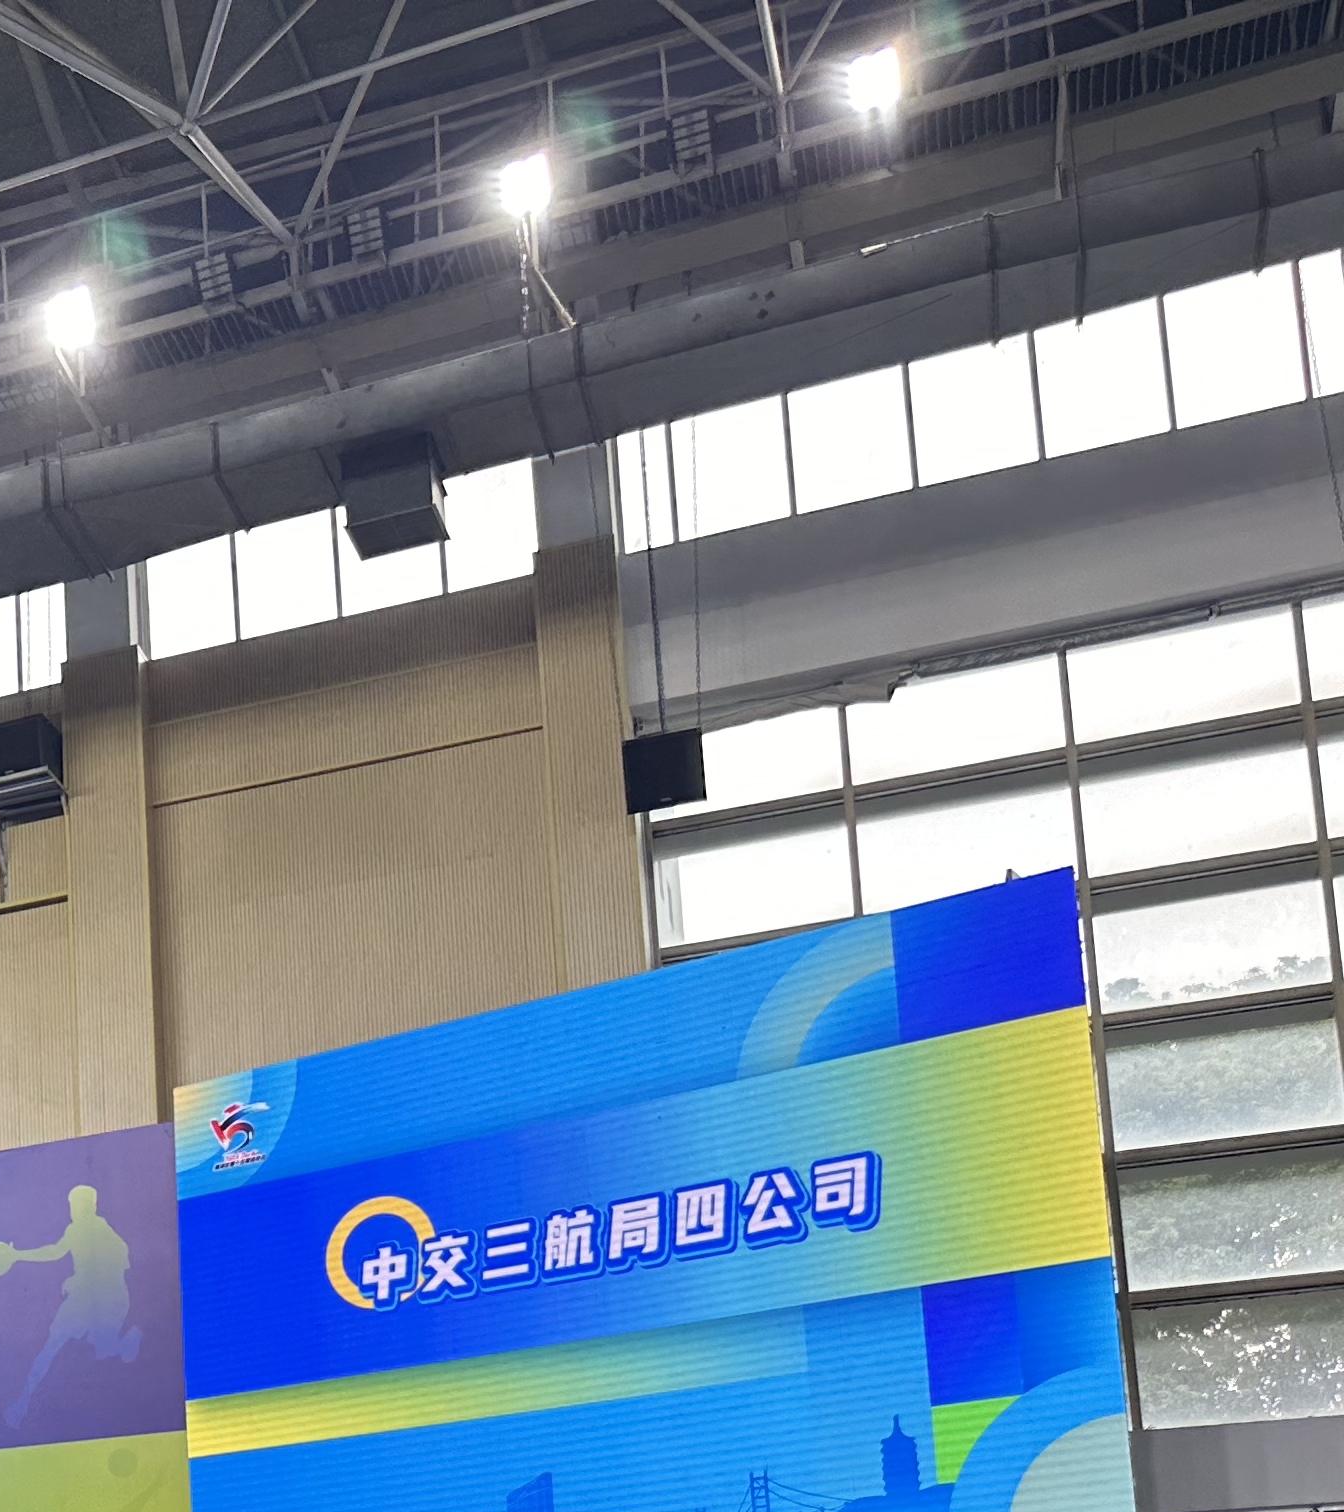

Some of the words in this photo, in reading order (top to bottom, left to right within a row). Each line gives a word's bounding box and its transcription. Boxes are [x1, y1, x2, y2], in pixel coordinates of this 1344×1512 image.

[360, 1153, 869, 1302] 中交三航局四公司
